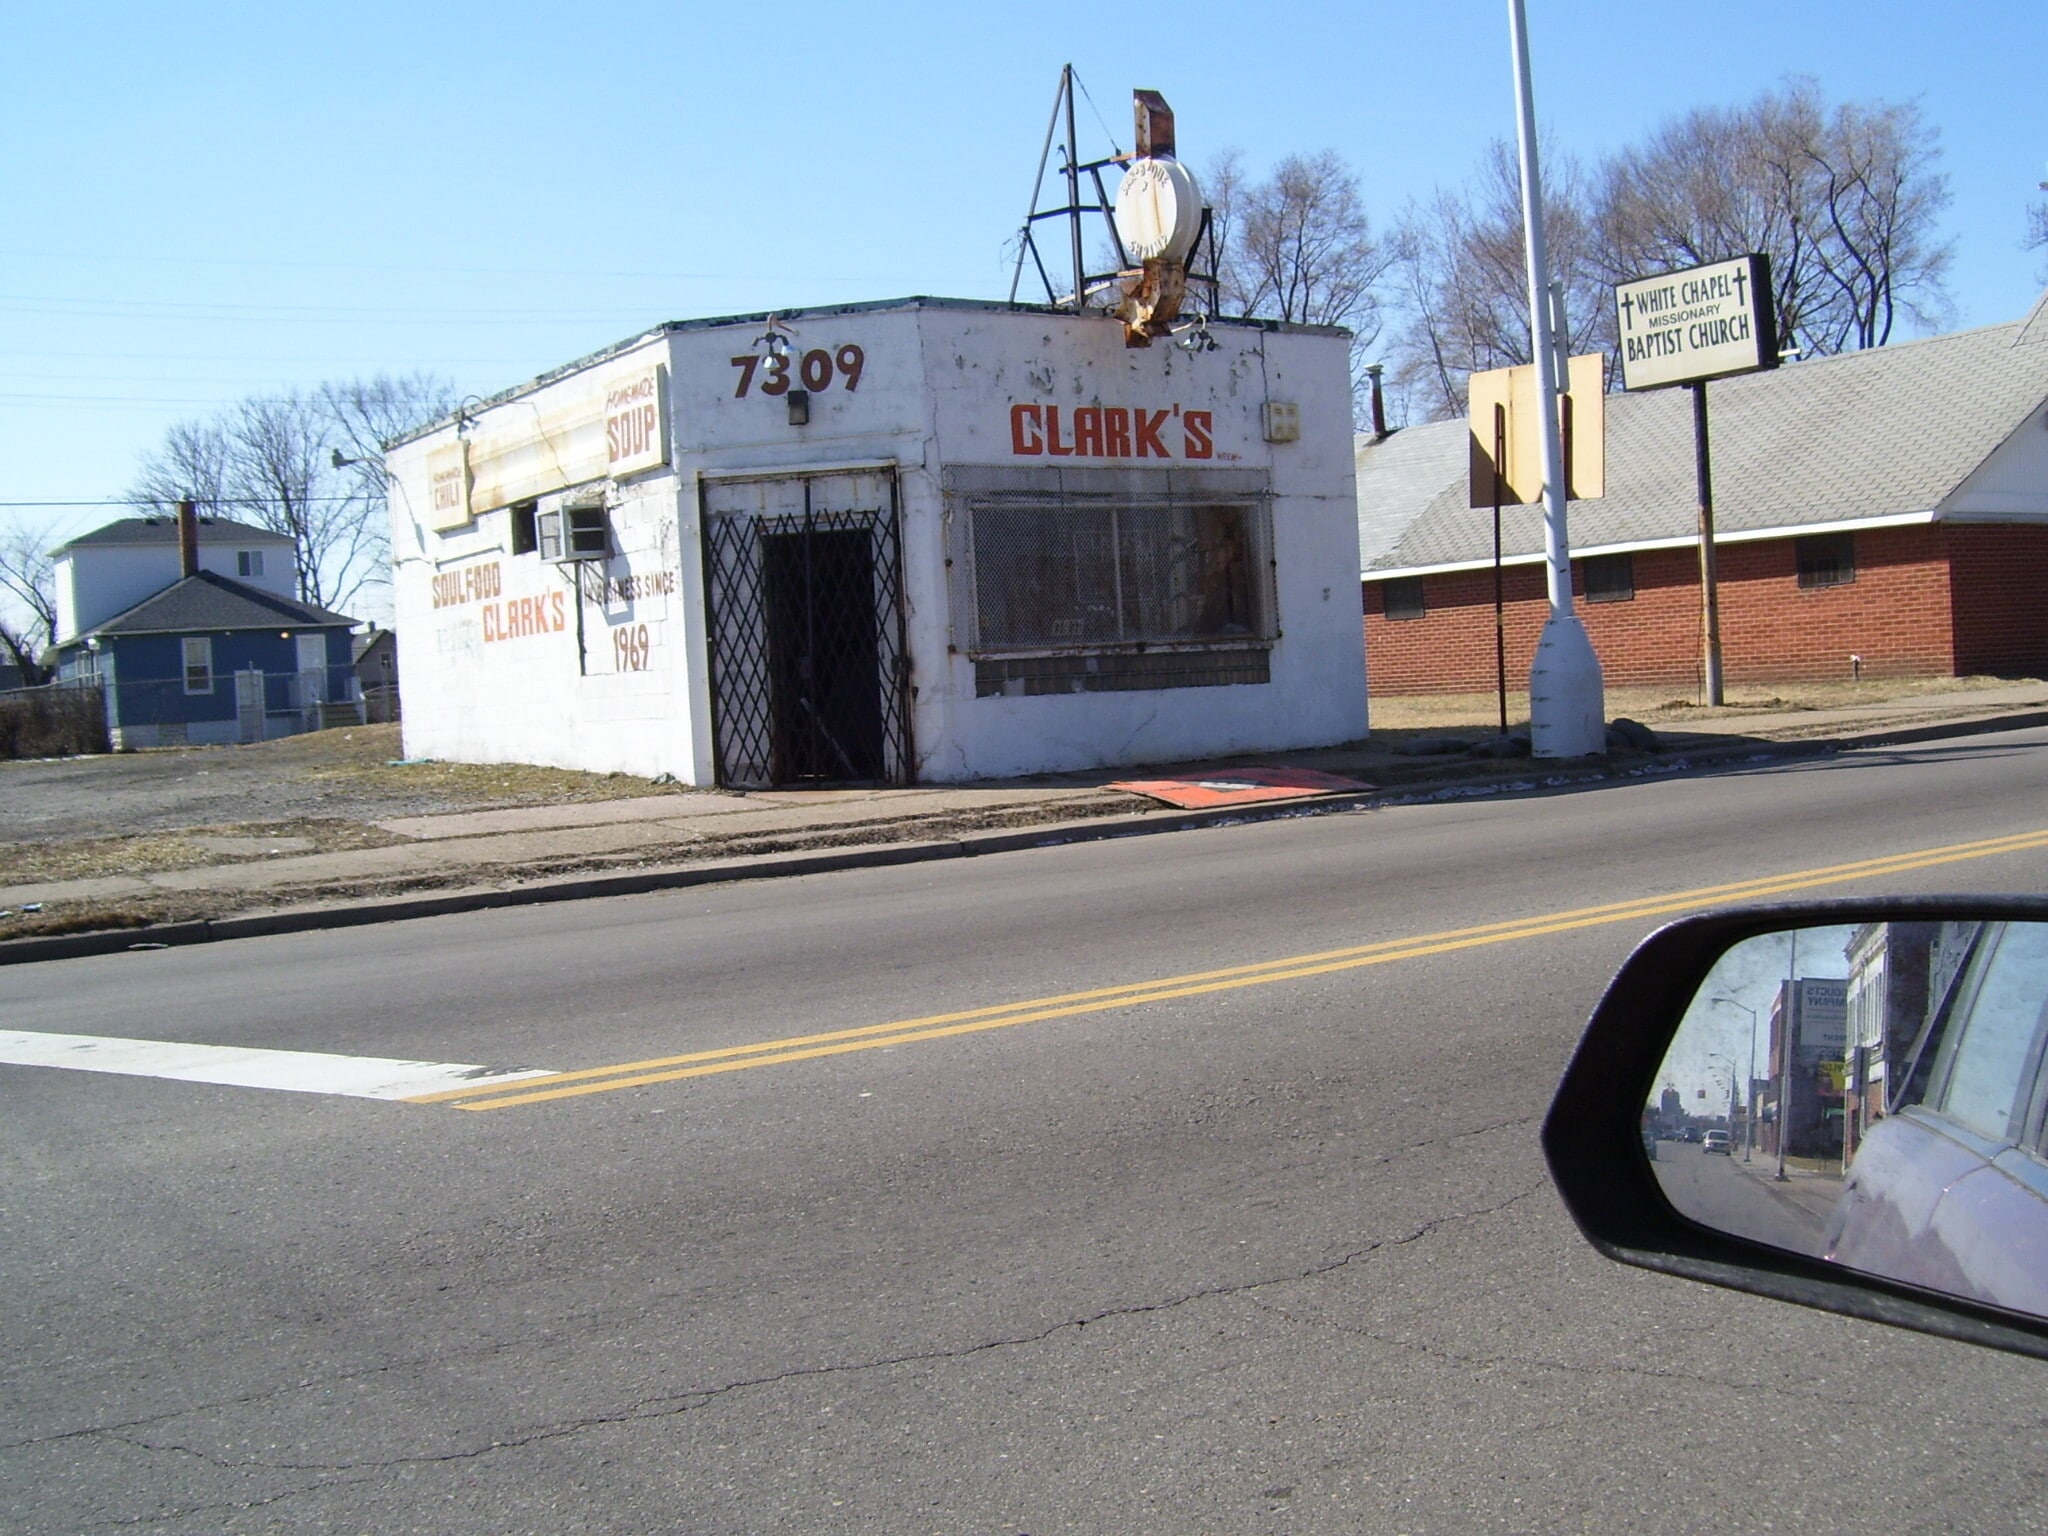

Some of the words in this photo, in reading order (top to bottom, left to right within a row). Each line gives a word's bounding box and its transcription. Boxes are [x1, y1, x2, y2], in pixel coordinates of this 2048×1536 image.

[1636, 285, 1677, 314] WHITE
[1681, 273, 1732, 305] CHAPEL
[1648, 303, 1721, 328] MISSIONARY
[1627, 327, 1682, 362] BAPTIST
[1688, 313, 1750, 349] CHURCH
[730, 344, 865, 398] 7309
[606, 403, 656, 463] SOUP
[1010, 402, 1213, 460] CLARK'S
[645, 570, 674, 596] SINCE
[482, 586, 565, 642] CLARK'S
[613, 623, 649, 673] 1969
